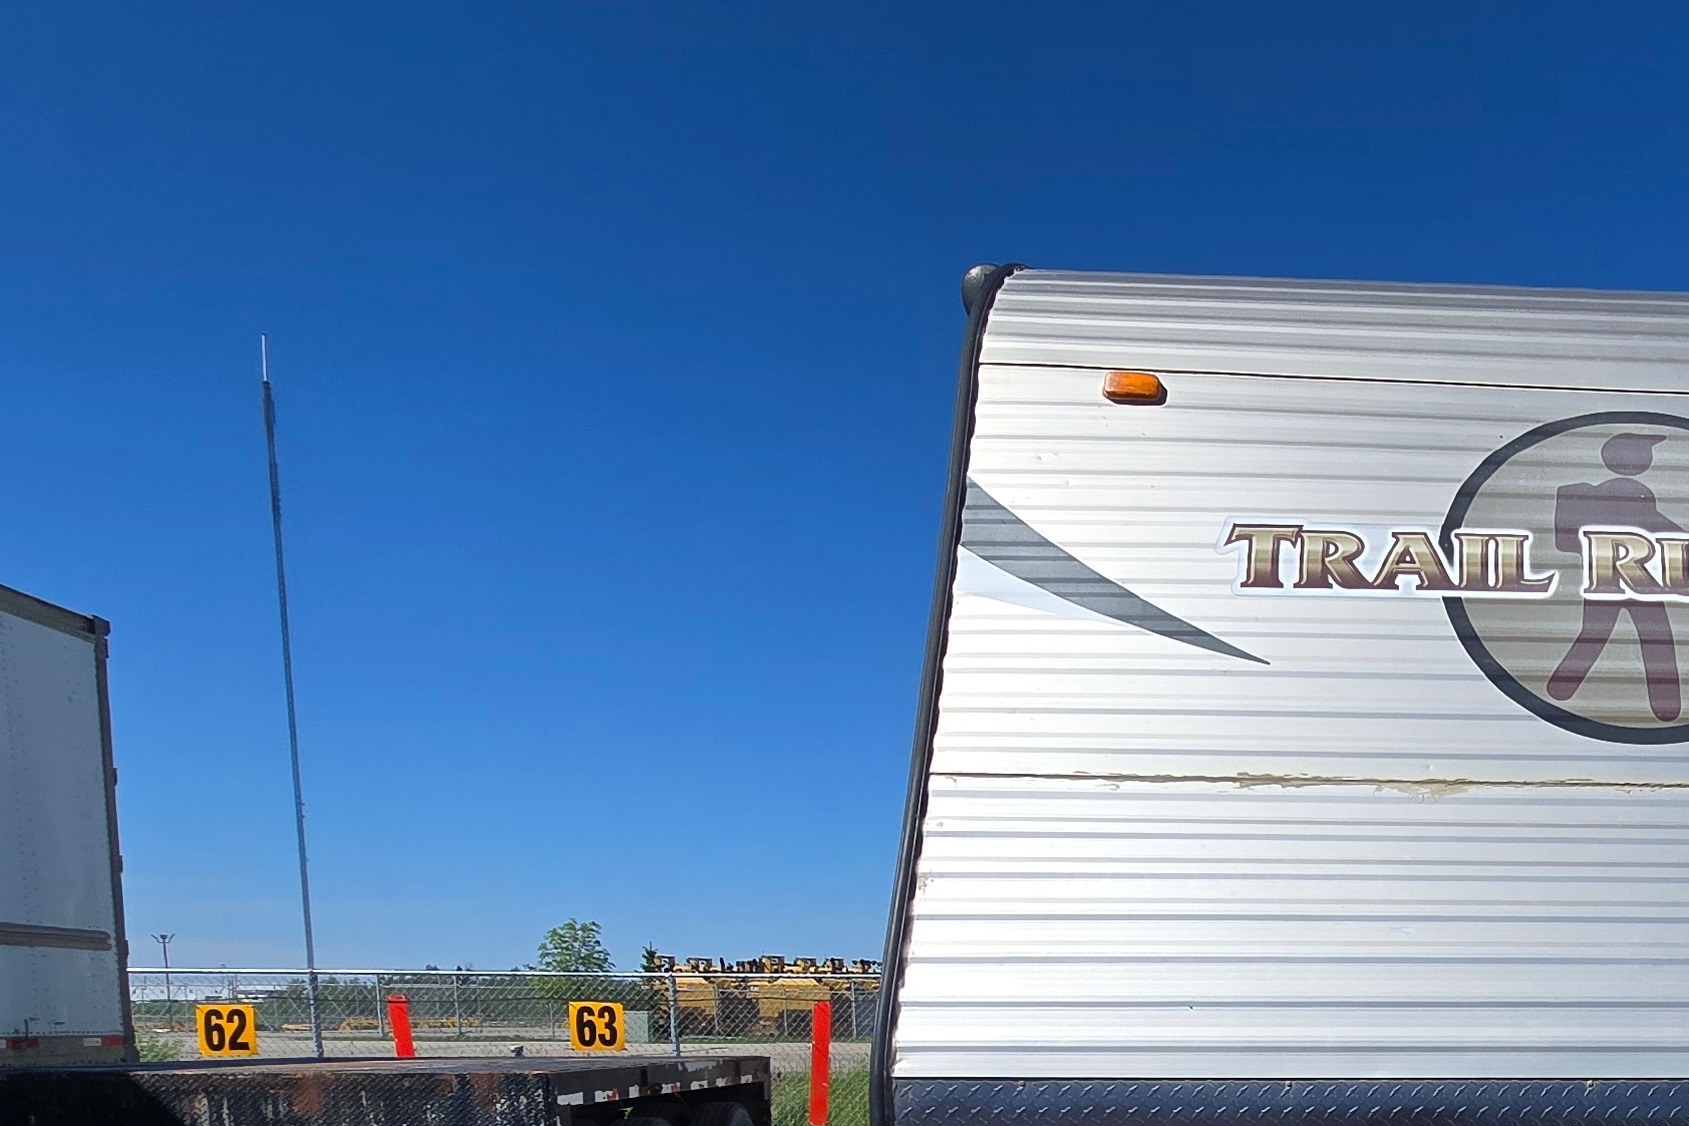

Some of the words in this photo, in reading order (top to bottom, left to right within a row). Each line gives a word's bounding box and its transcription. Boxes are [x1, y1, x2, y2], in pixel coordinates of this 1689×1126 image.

[1224, 523, 1556, 593] TRAIL
[204, 1008, 251, 1052] 62
[575, 1005, 618, 1047] 63
